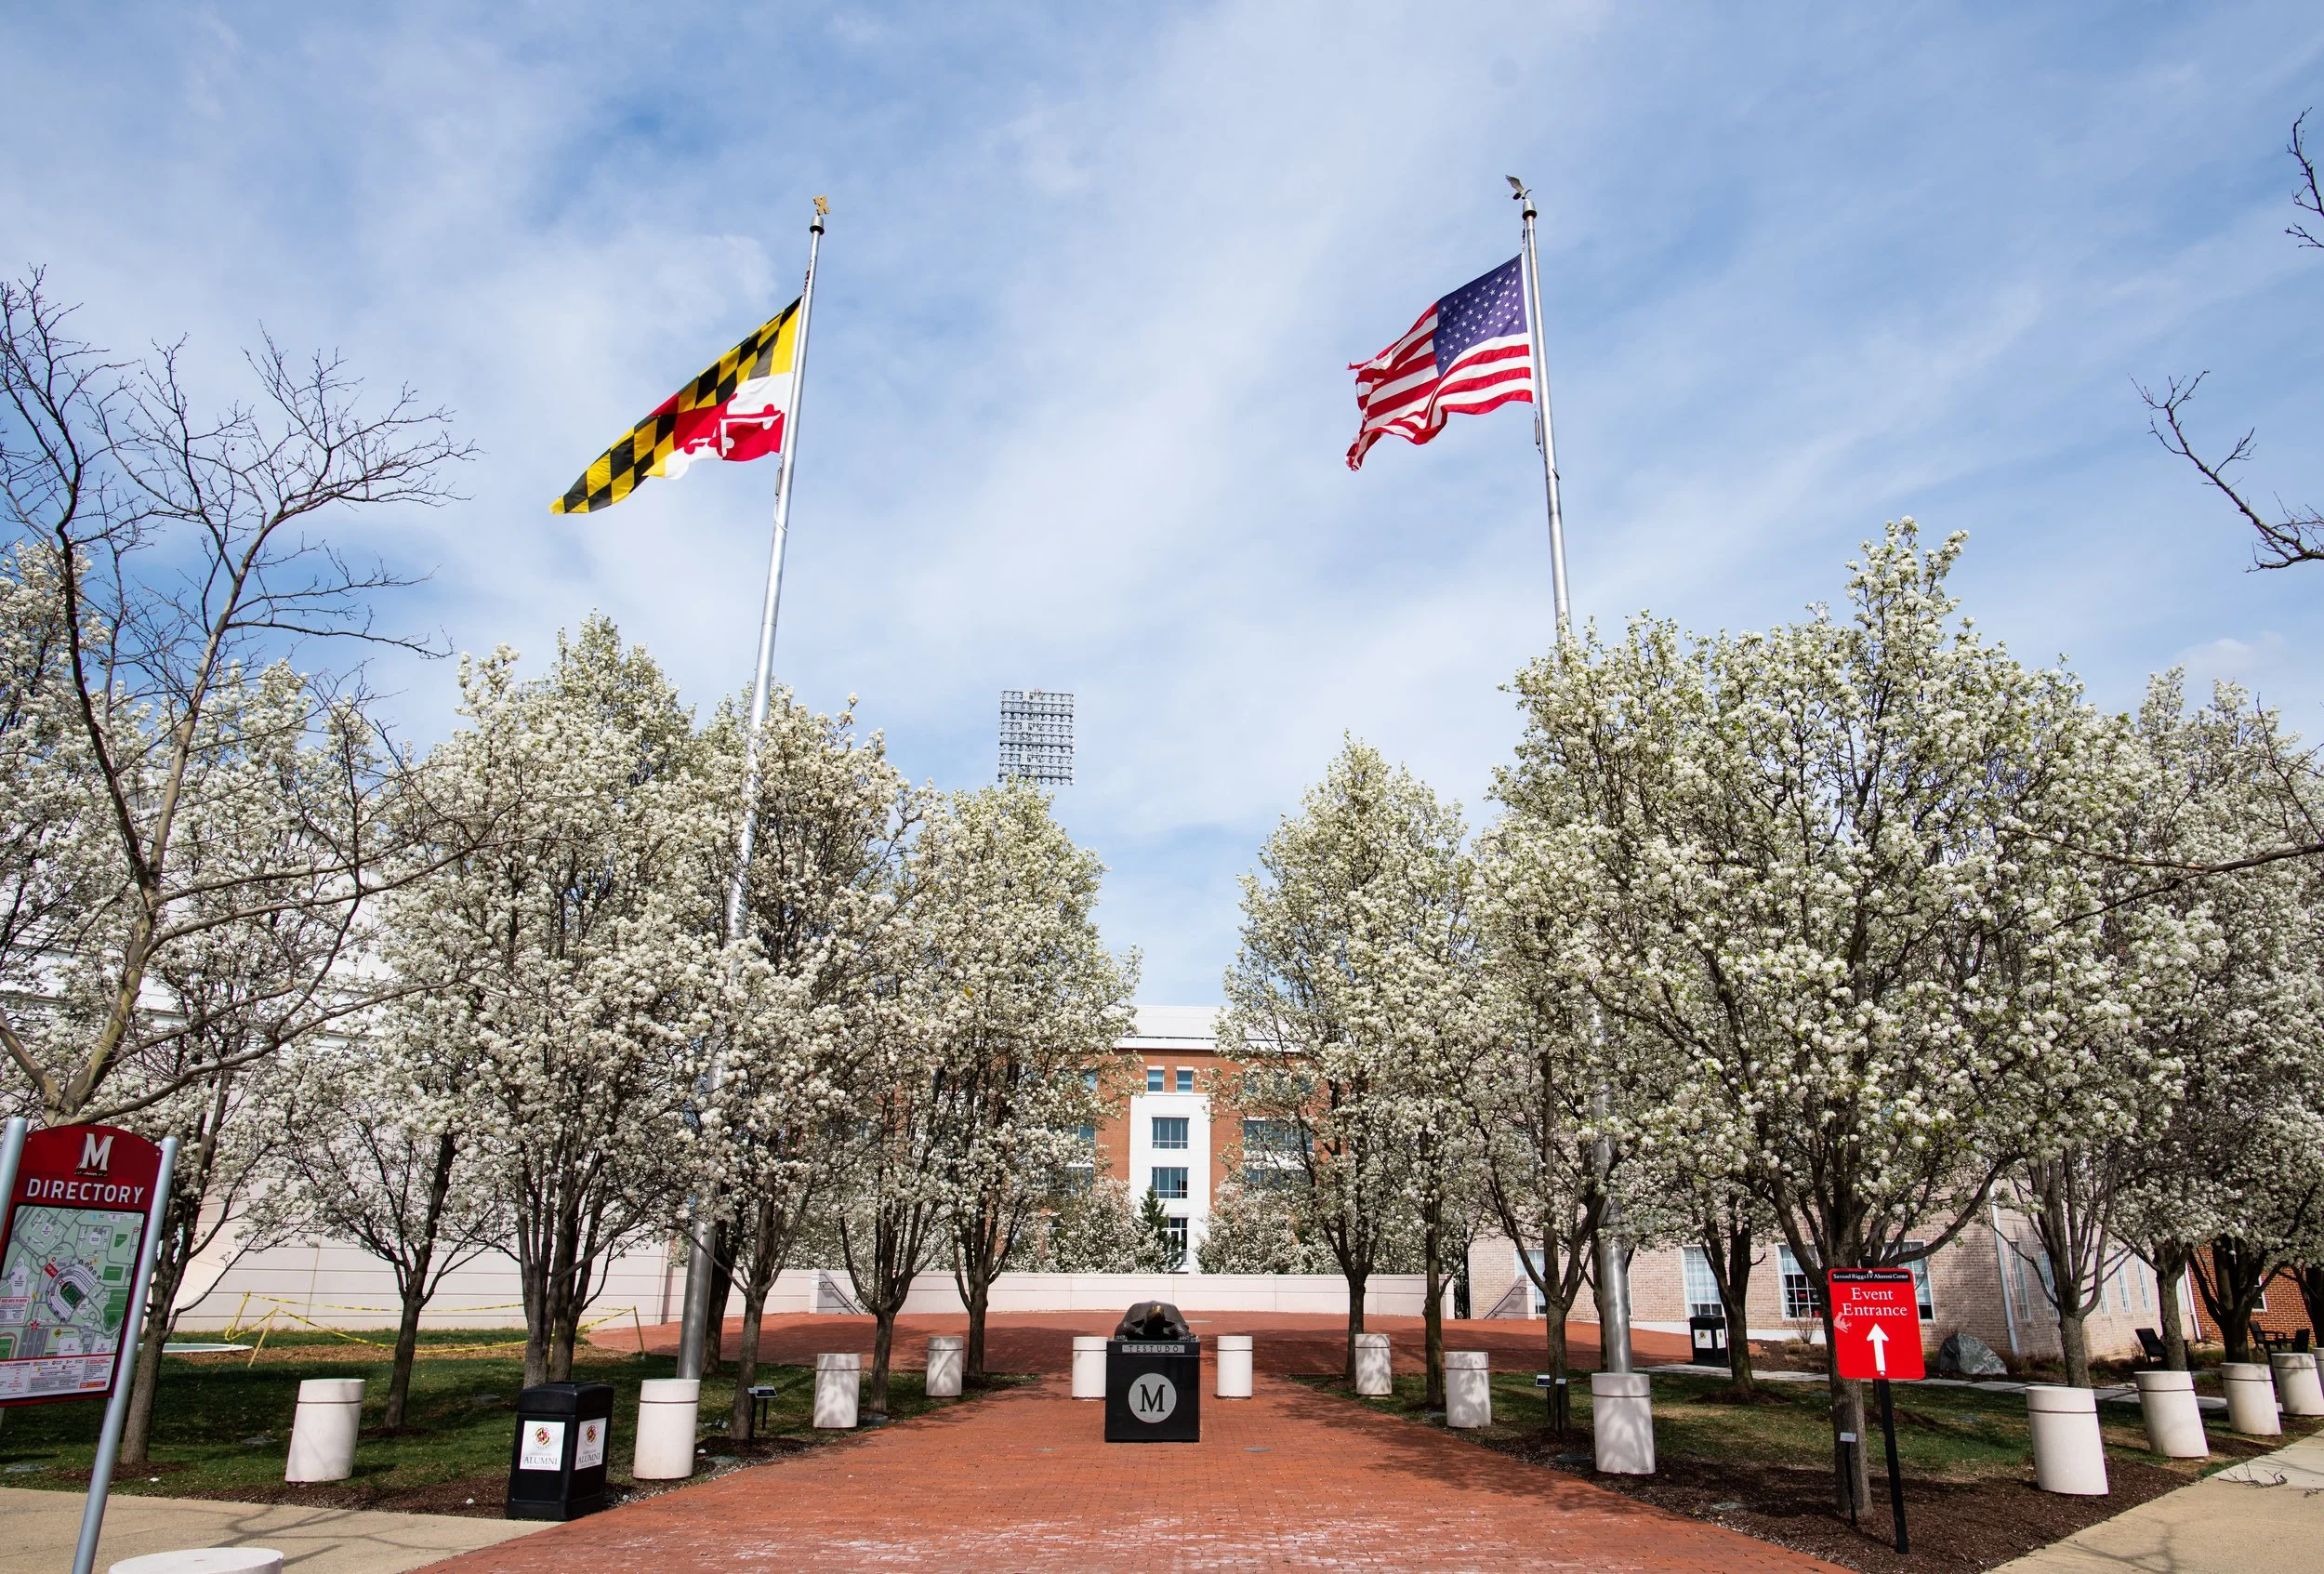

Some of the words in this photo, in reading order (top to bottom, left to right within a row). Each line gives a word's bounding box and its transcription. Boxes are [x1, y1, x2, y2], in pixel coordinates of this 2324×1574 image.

[76, 1132, 114, 1171] M
[26, 1178, 145, 1204] DIRECTORY
[1851, 1288, 1894, 1300] Event
[1842, 1303, 1908, 1316] Entrance
[1140, 1384, 1165, 1412] M
[578, 1453, 601, 1463] ALUMNI
